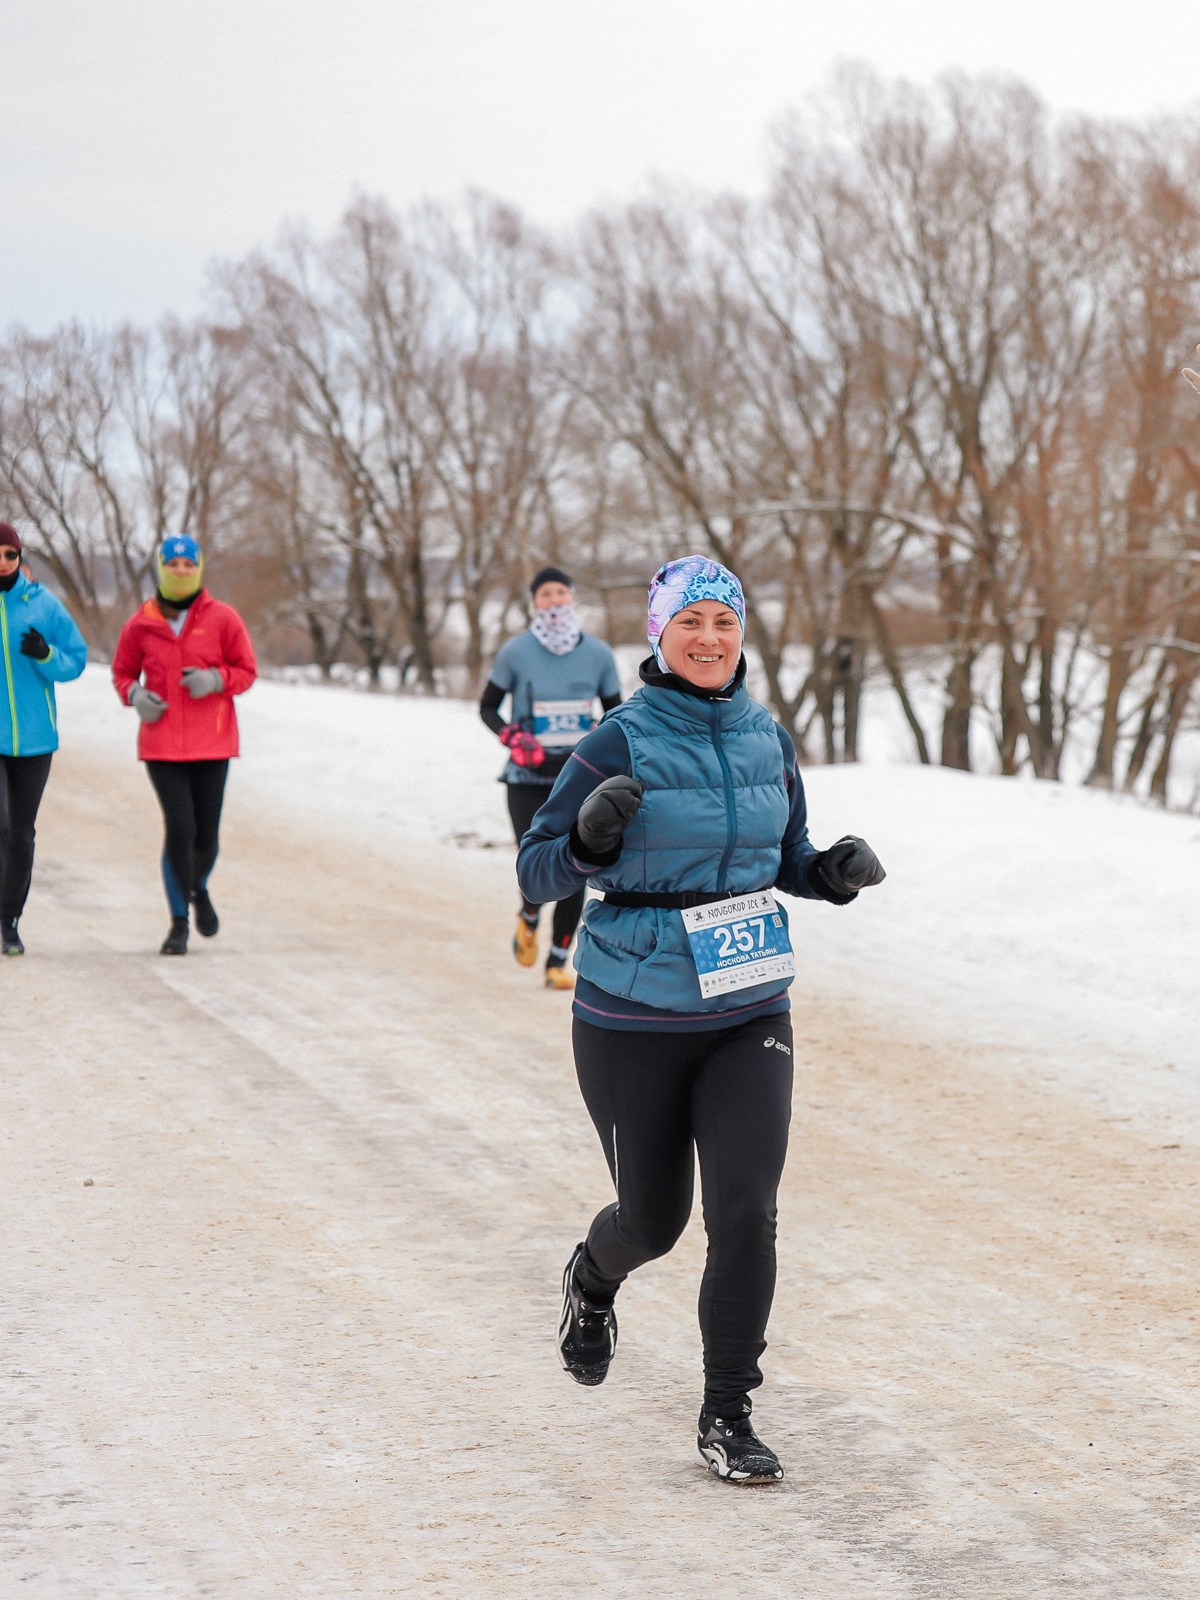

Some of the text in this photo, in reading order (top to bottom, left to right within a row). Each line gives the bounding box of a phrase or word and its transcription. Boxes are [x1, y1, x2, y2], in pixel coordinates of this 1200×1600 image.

[707, 901, 746, 919] NOVGOROD
[713, 918, 766, 958] 257
[716, 954, 751, 969] НОСКОВА
[750, 947, 778, 960] ТАТЬЯНА
